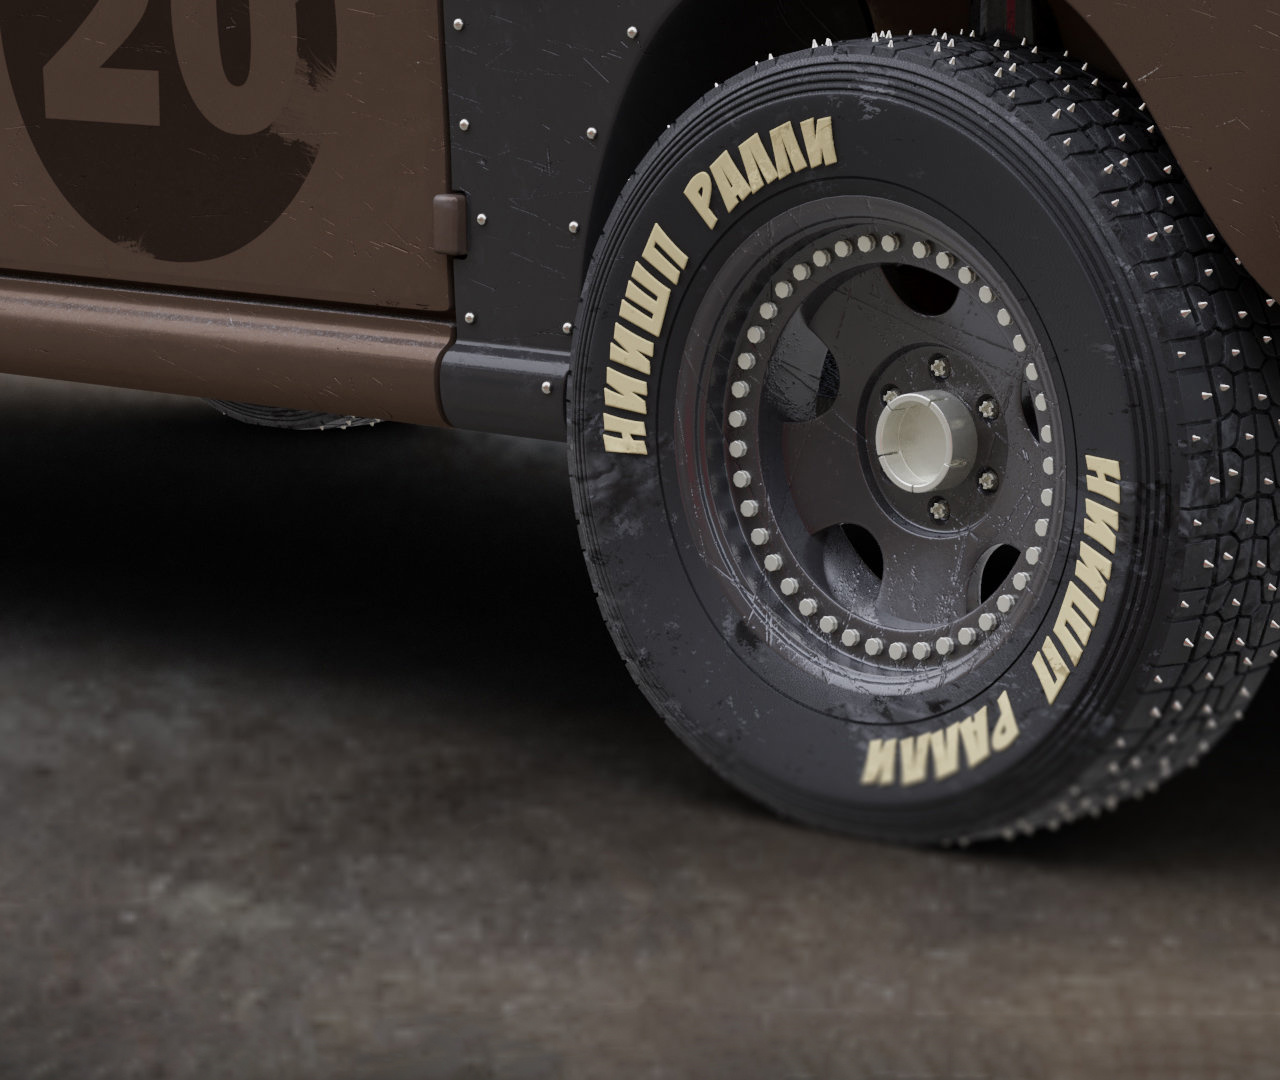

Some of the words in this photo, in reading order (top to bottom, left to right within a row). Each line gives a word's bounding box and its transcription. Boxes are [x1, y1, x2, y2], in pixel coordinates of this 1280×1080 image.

[603, 223, 689, 456] НИИШП
[683, 115, 838, 231] РАЛЛИ
[1031, 454, 1121, 706] НИИШП
[860, 689, 1020, 787] РАЛЛИ
